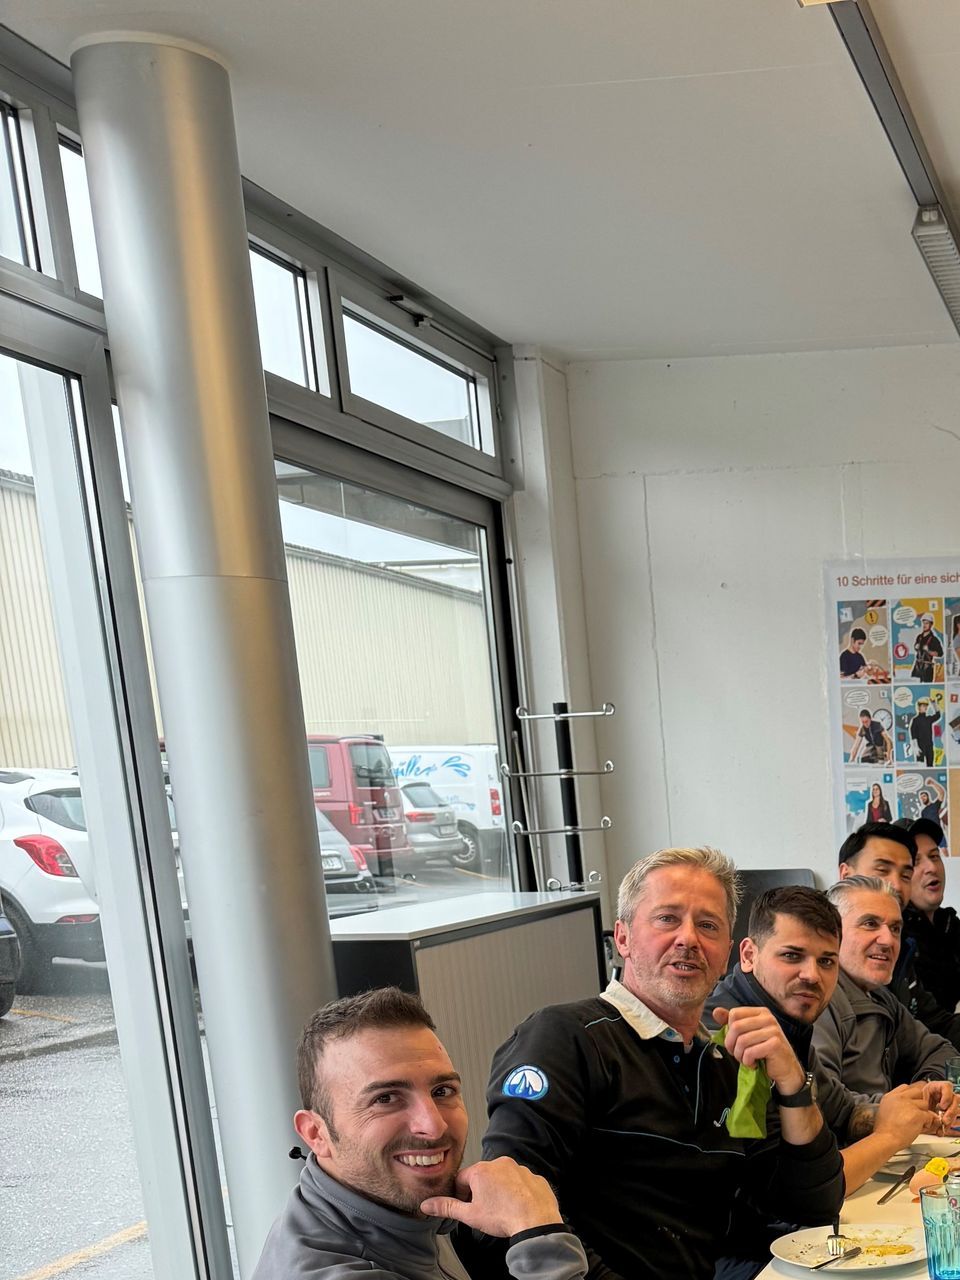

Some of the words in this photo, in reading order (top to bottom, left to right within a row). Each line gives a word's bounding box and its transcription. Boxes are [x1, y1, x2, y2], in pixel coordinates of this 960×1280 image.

[836, 576, 849, 587] 10
[851, 574, 894, 587] Schritte
[897, 573, 913, 585] für
[914, 573, 938, 585] eine
[393, 754, 438, 777] üller
